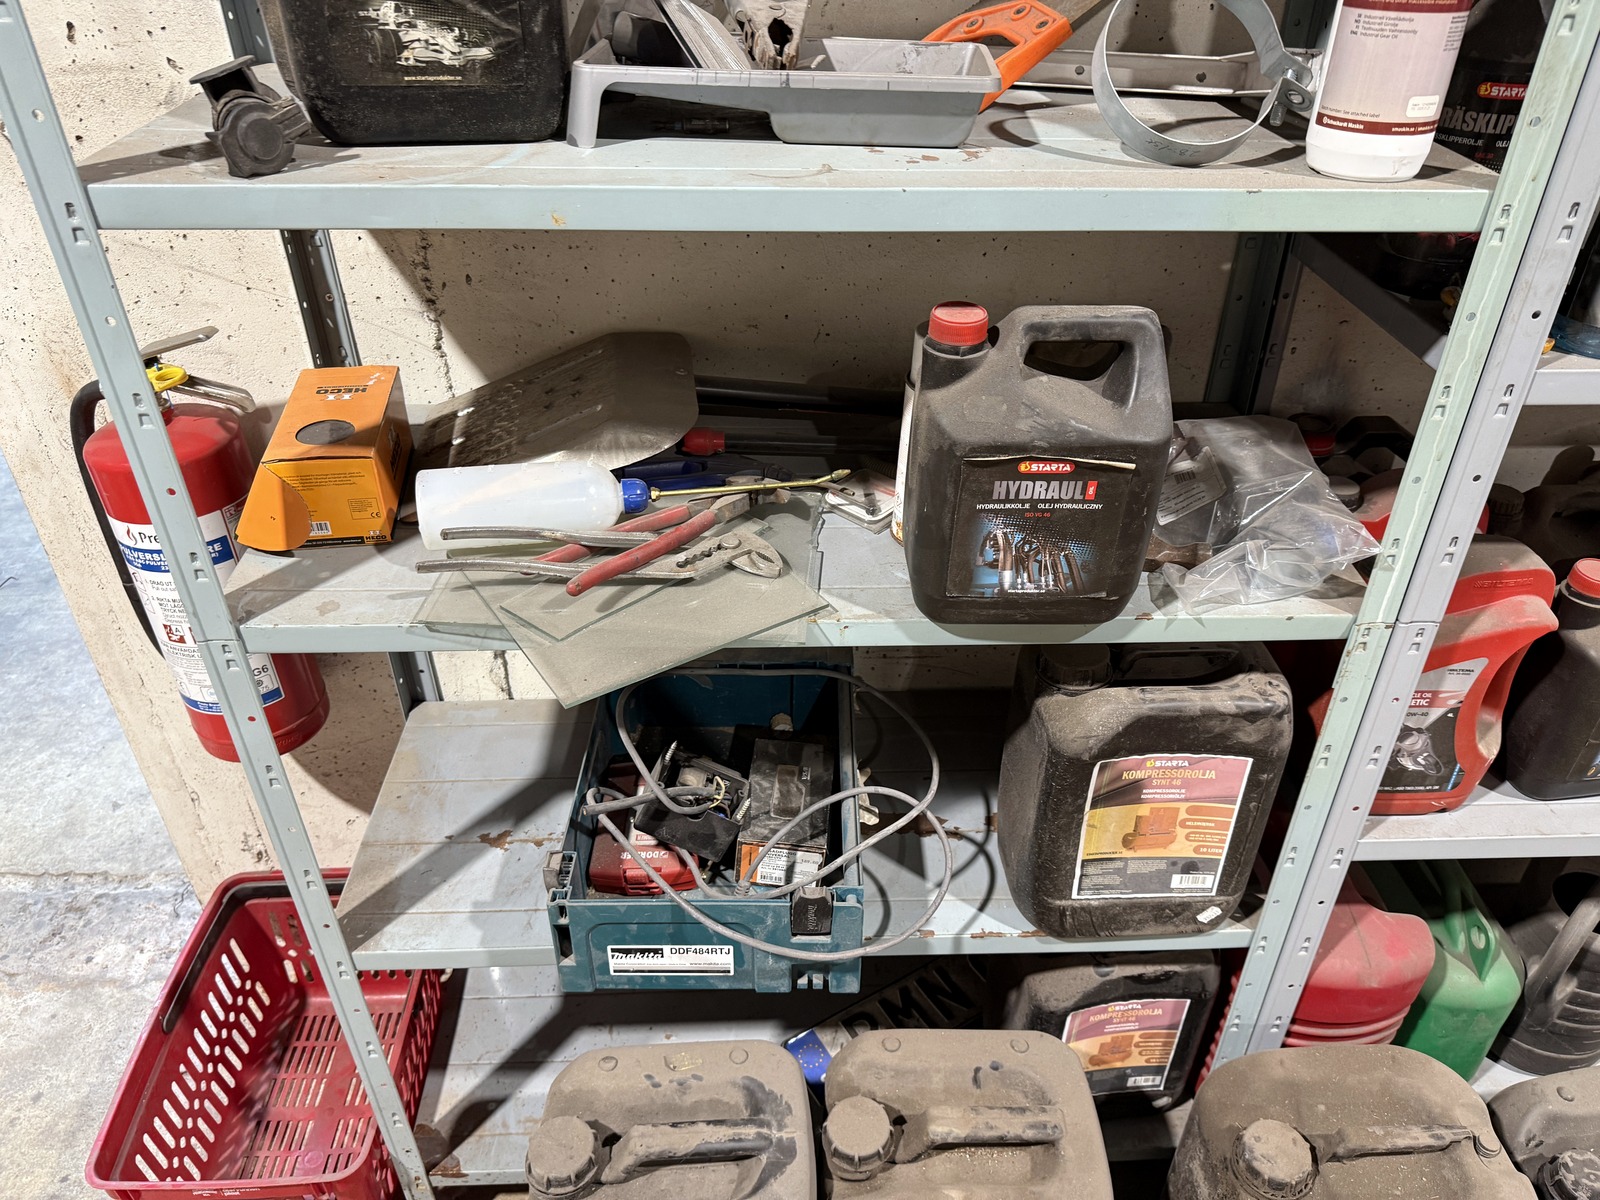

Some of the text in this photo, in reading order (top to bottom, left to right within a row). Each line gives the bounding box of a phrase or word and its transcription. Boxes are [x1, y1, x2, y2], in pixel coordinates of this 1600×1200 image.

[1360, 30, 1380, 38] Industrial
[1440, 106, 1519, 135] RÄSKLIP
[316, 387, 368, 395] HECO
[1030, 463, 1071, 472] STARTA
[992, 480, 1083, 500] HYDRAUL
[1121, 769, 1216, 780] KOMPRESSOROLJA
[620, 851, 659, 859] DORER
[611, 951, 664, 960] makita
[670, 947, 731, 955] DDF484RTJ
[1114, 1003, 1142, 1011] STARTA
[1089, 1008, 1163, 1022] KOMPRESSOROLJA
